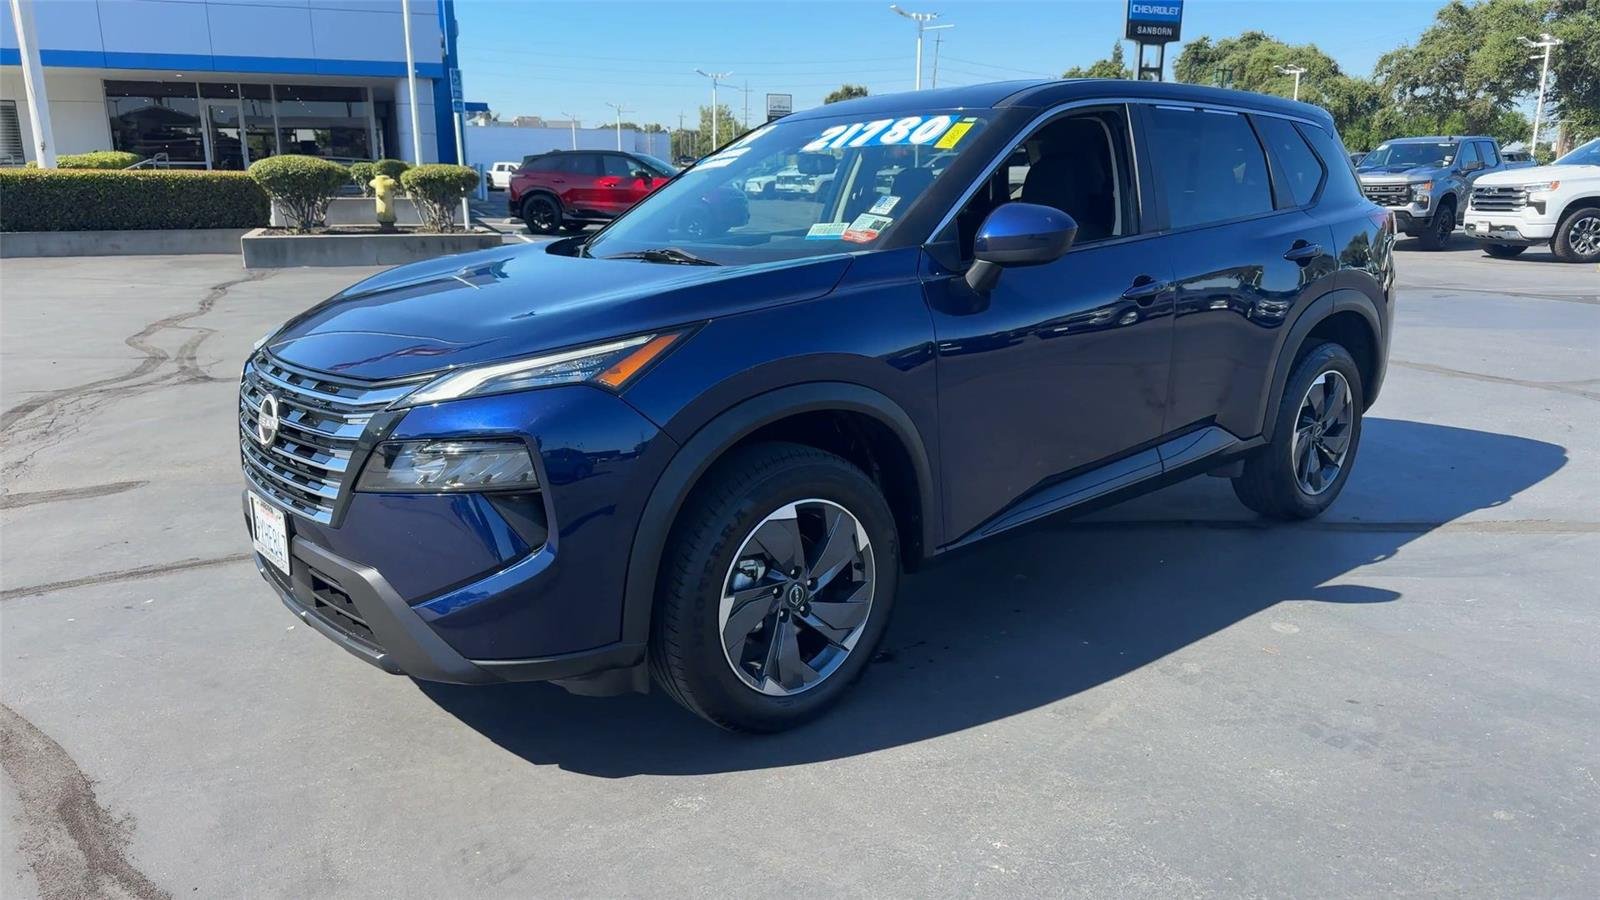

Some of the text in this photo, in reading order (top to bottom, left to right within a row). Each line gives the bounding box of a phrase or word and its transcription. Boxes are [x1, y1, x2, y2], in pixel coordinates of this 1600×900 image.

[1133, 4, 1179, 15] CHEVROLET
[1137, 26, 1173, 36] SANBORN
[799, 115, 951, 151] 21780
